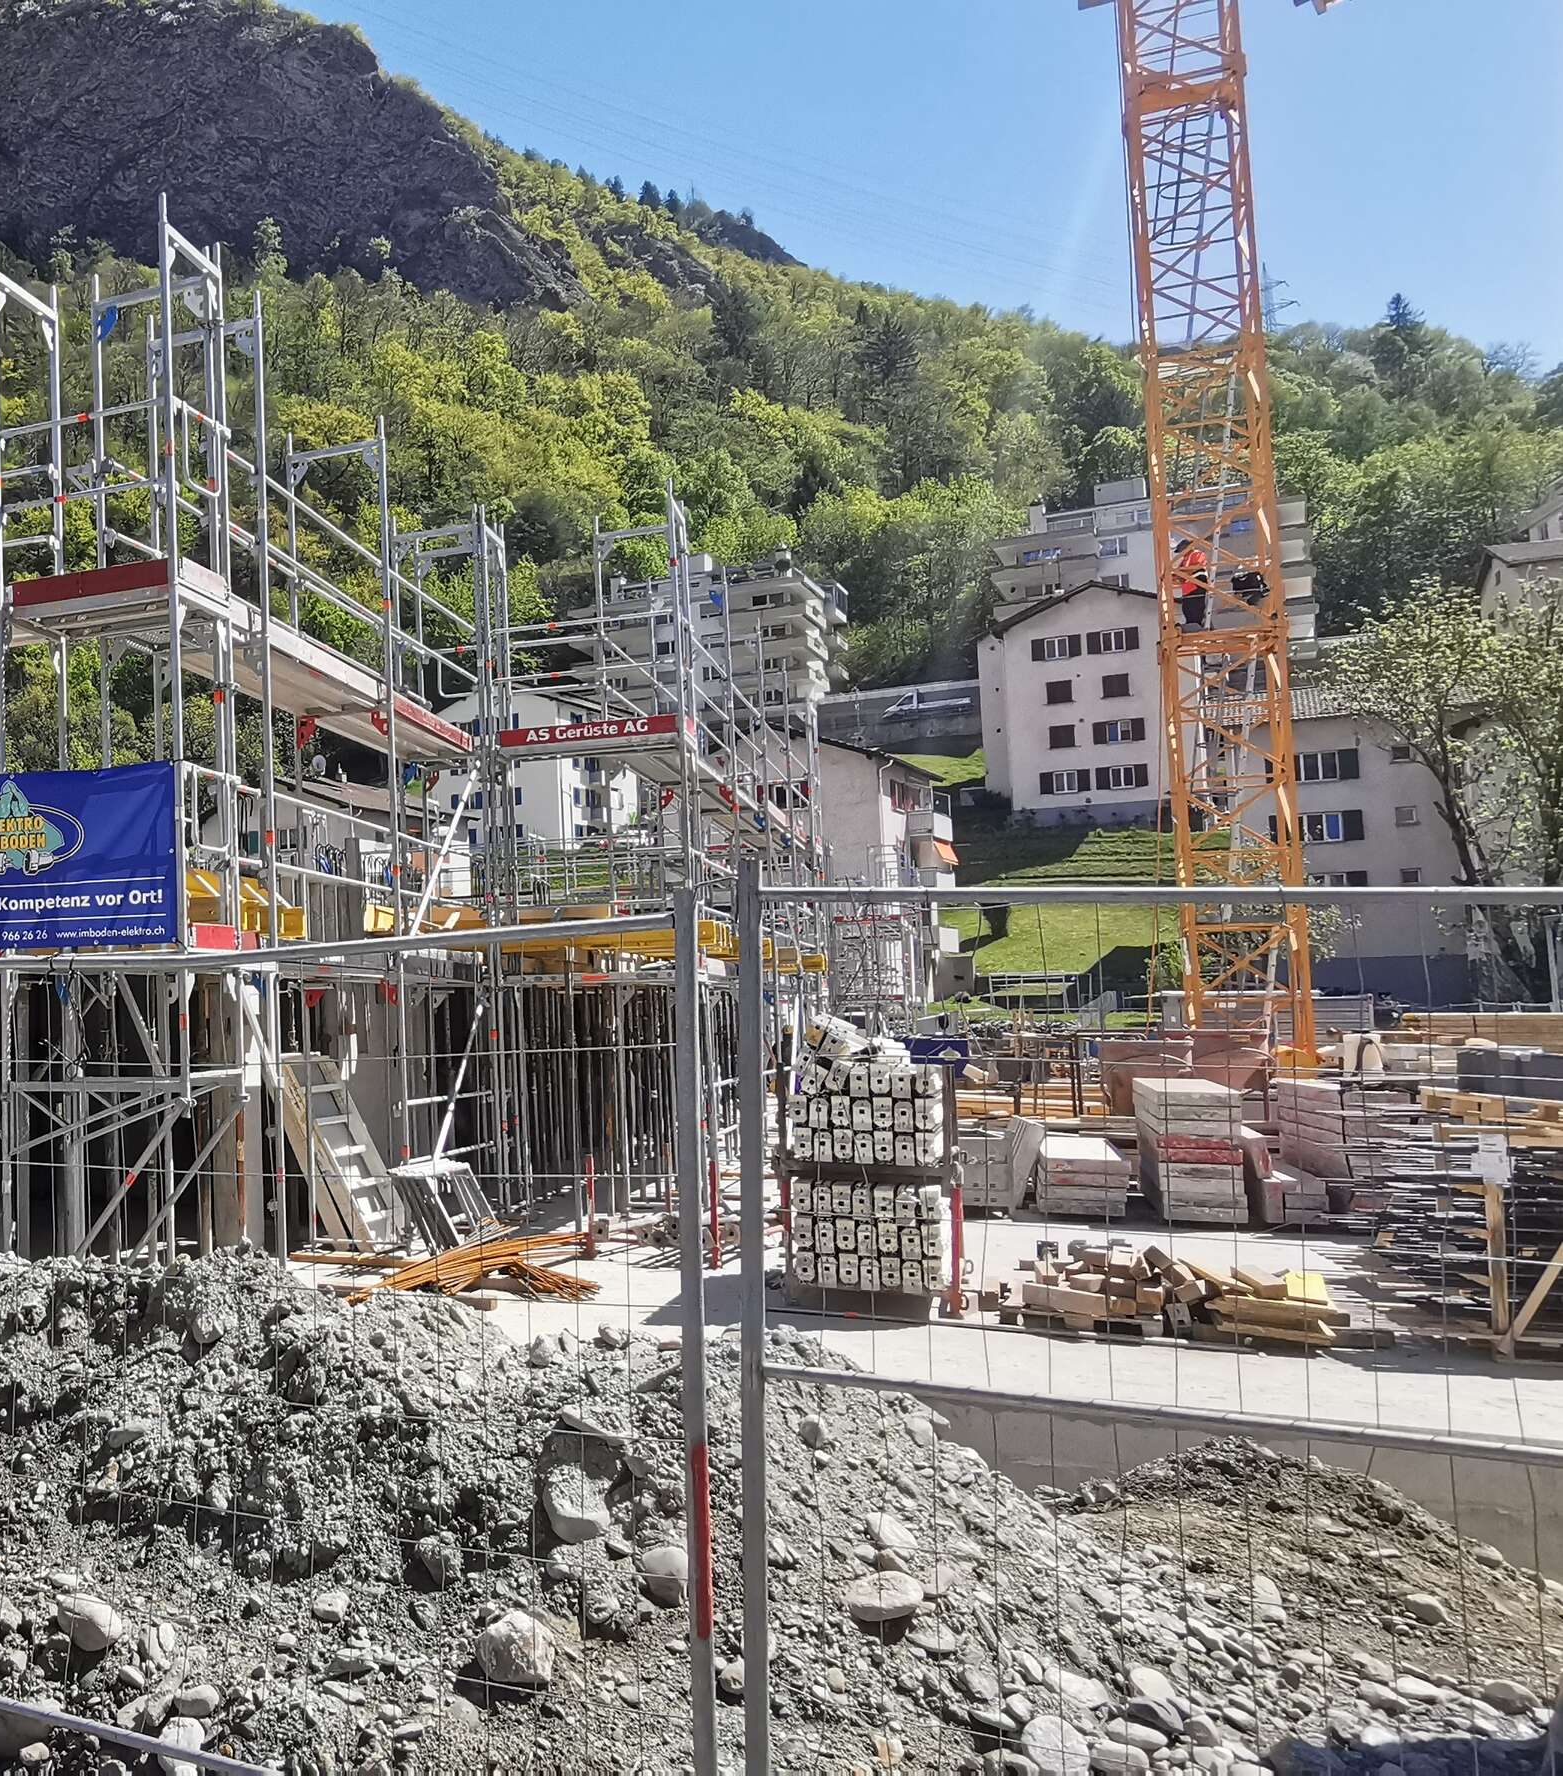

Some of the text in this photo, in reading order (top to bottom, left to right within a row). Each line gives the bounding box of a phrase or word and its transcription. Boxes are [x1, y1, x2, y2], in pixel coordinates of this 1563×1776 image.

[526, 719, 649, 743] AS Gerüste AG
[95, 892, 124, 906] vor
[128, 889, 164, 905] Ort!
[1, 930, 20, 941] 966
[22, 930, 34, 941] 26
[37, 930, 48, 940] 26
[55, 924, 166, 939] www.imboden-elektro.ch
